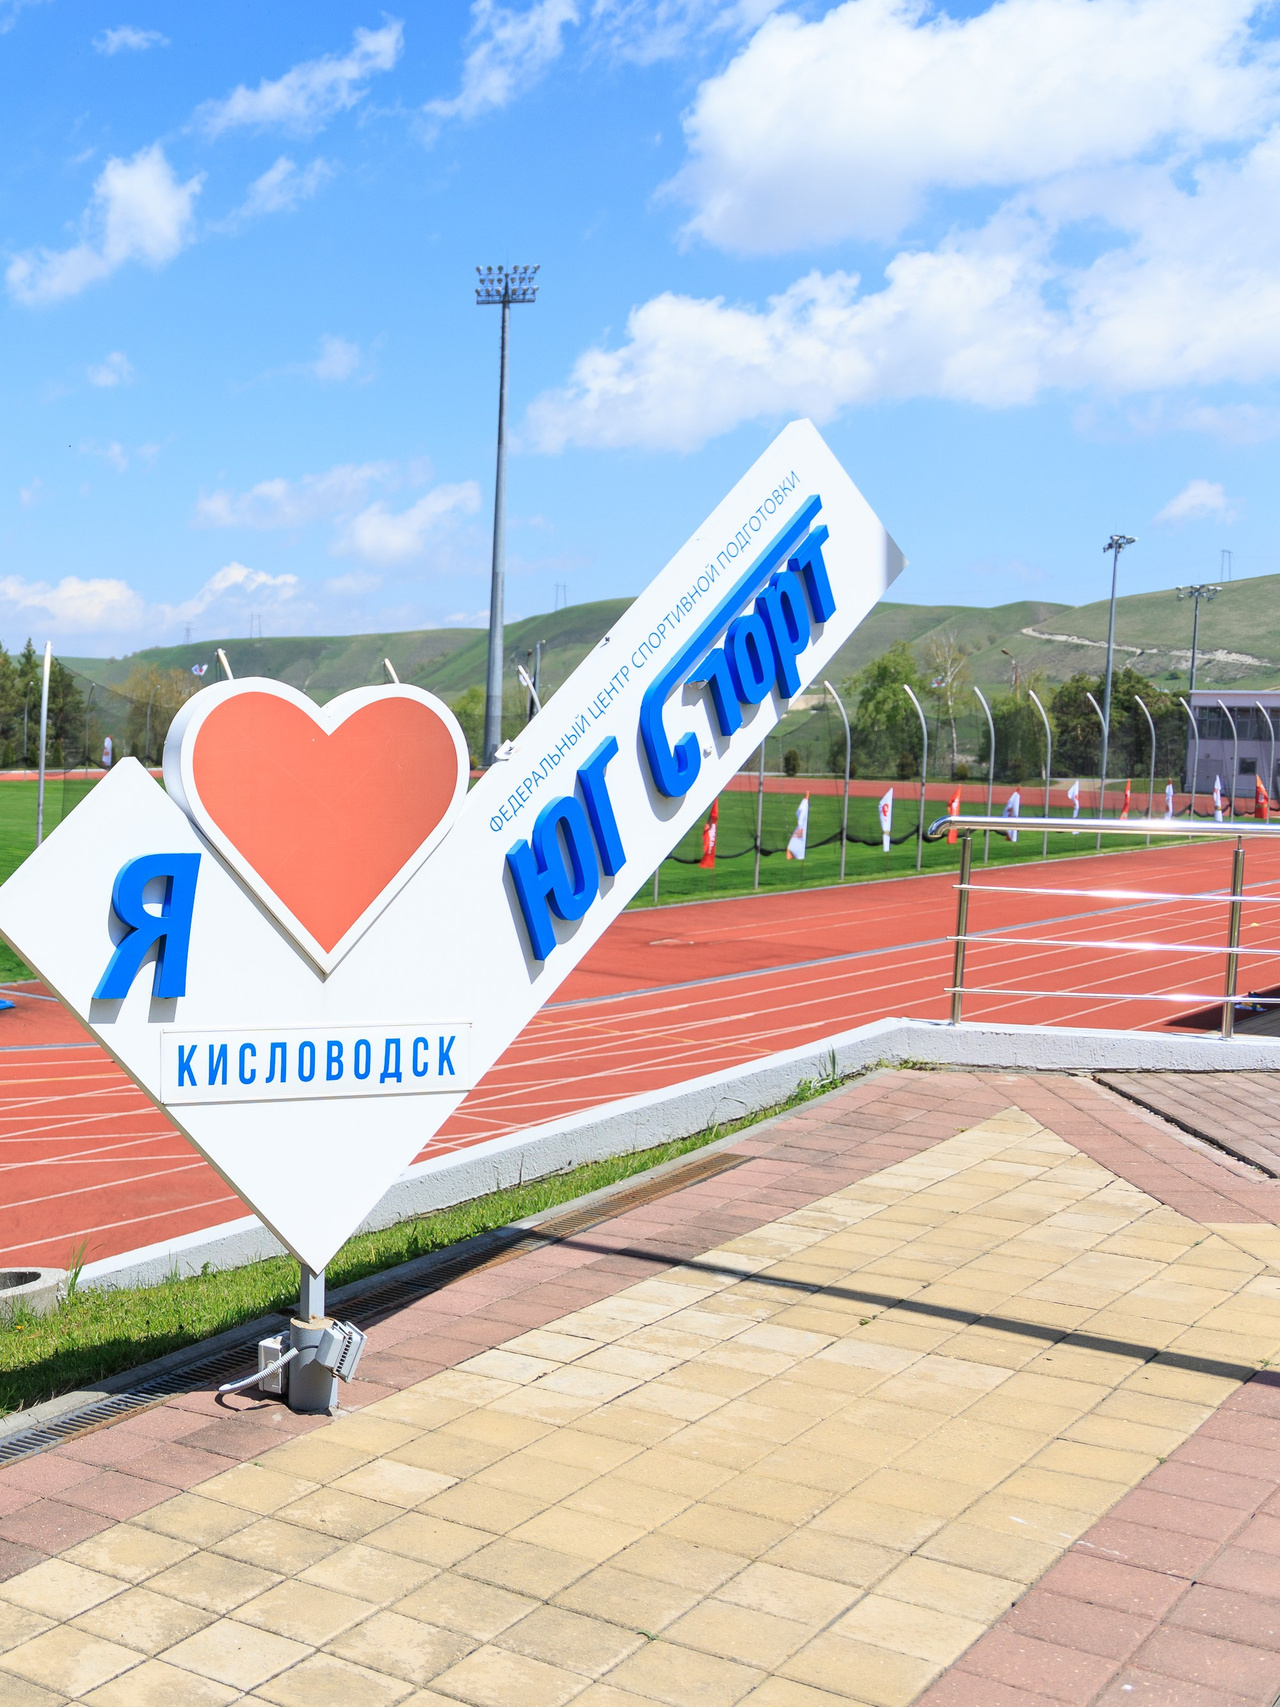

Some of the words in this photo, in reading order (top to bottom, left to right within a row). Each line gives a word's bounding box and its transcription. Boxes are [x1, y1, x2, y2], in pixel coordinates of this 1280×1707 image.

[489, 714, 591, 832] ФЕДЕРАЛЬНЫЙ
[587, 665, 630, 719] ЦЕНТР
[631, 563, 721, 669] СПОРТИВНОЙ
[716, 470, 801, 570] ПОДГОТОВКИ
[92, 852, 201, 1001] Я
[505, 736, 627, 962] ЮГ
[177, 1035, 456, 1087] КИСЛОВОДСК
